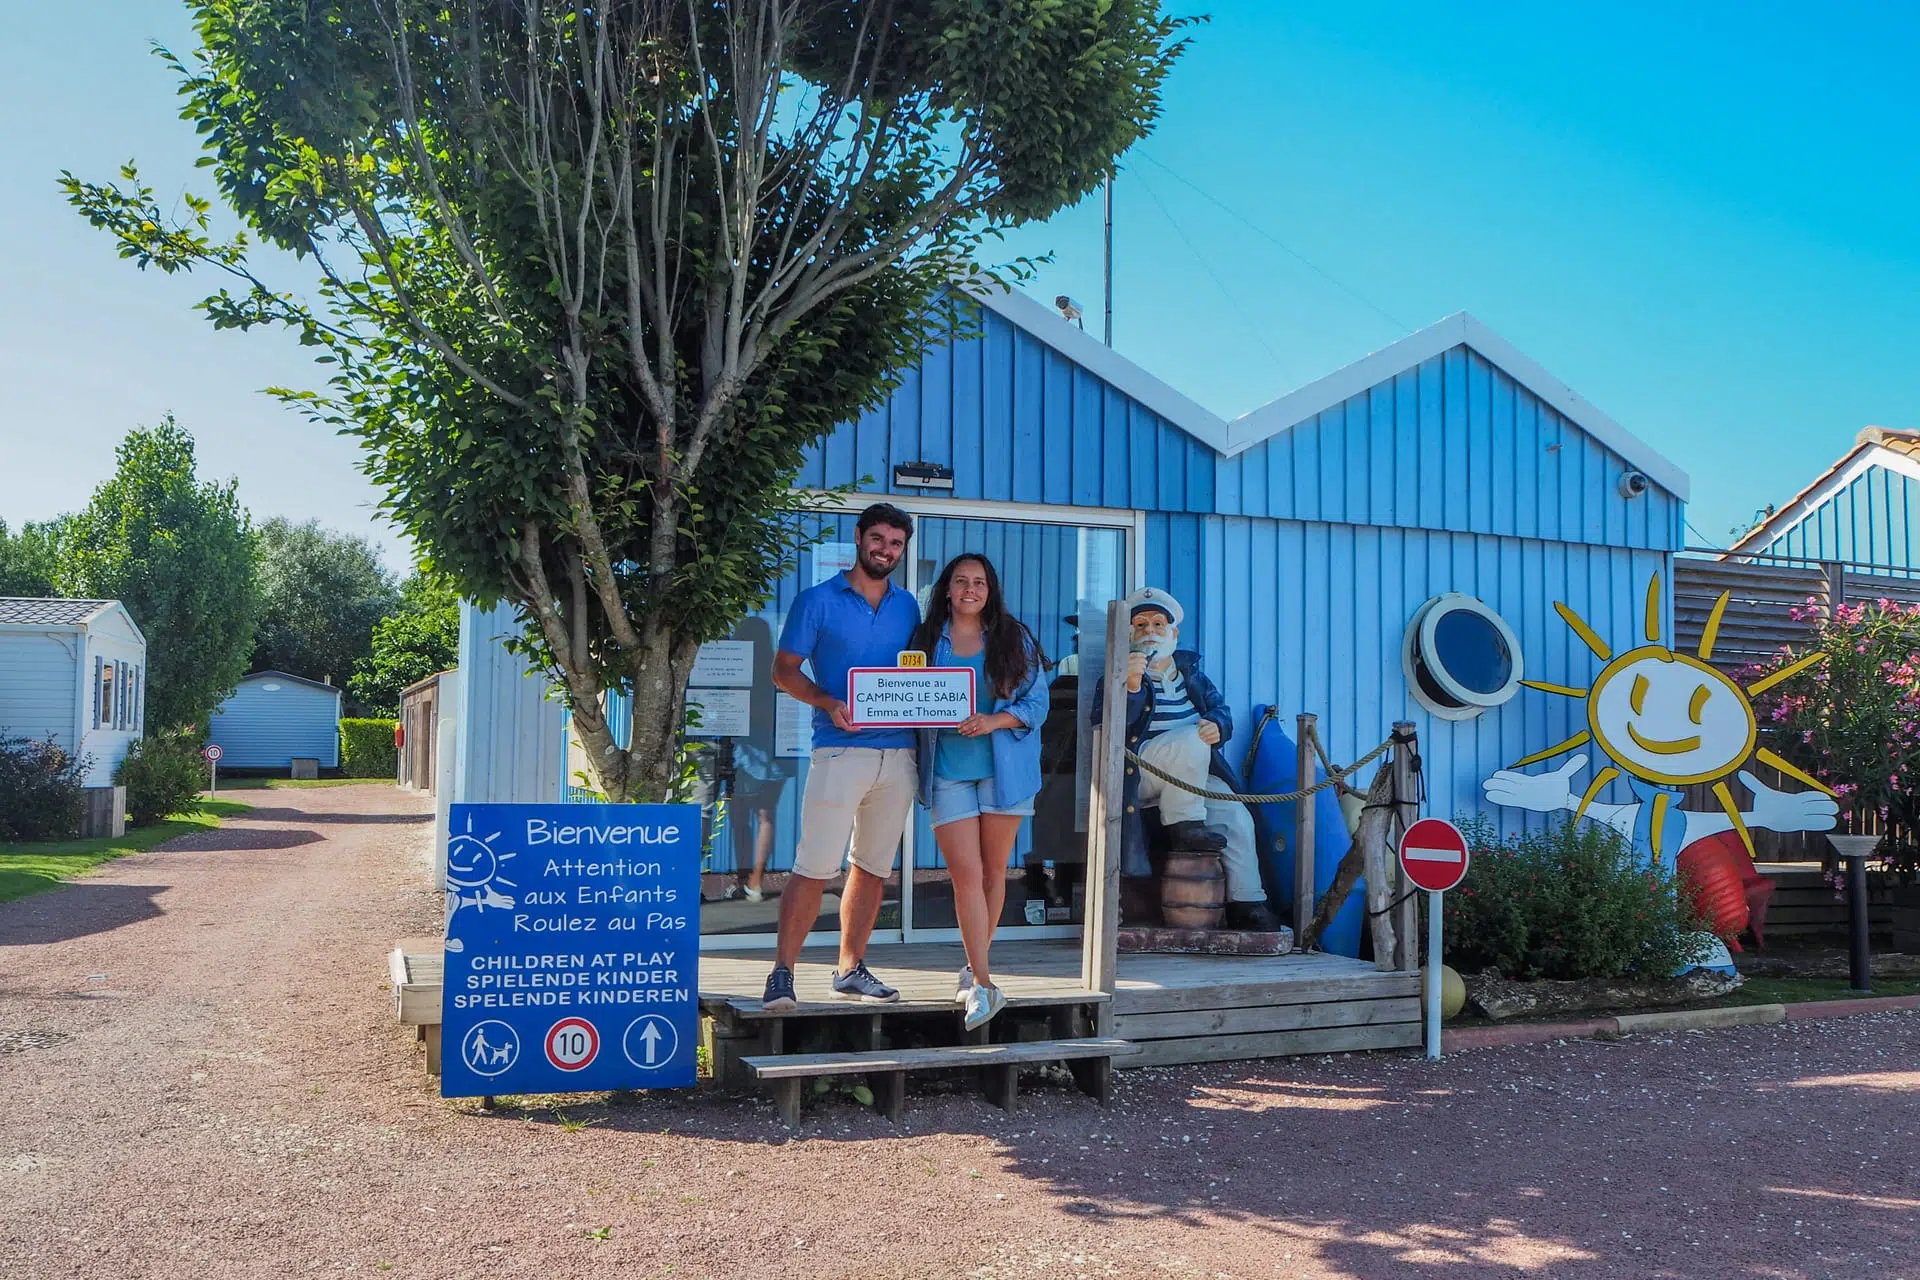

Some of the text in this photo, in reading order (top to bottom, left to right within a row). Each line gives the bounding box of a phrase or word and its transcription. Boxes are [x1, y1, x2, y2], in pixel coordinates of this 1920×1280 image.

[902, 655, 921, 666] D734
[878, 678, 931, 688] Bienvenue
[856, 692, 968, 702] CAMPING LE SABIA
[867, 706, 958, 717] Emma et Thomas
[526, 818, 680, 845] Bienvenue
[543, 859, 662, 878] Attention
[524, 885, 678, 906] aux Enfants
[514, 912, 687, 933] Roulez au Pas
[471, 952, 676, 970] CHILDREN AT PLAY
[466, 970, 678, 990] SPIELENDE KINDER
[454, 988, 689, 1008] SPELENDE KINDEREN
[559, 1032, 585, 1056] 10
